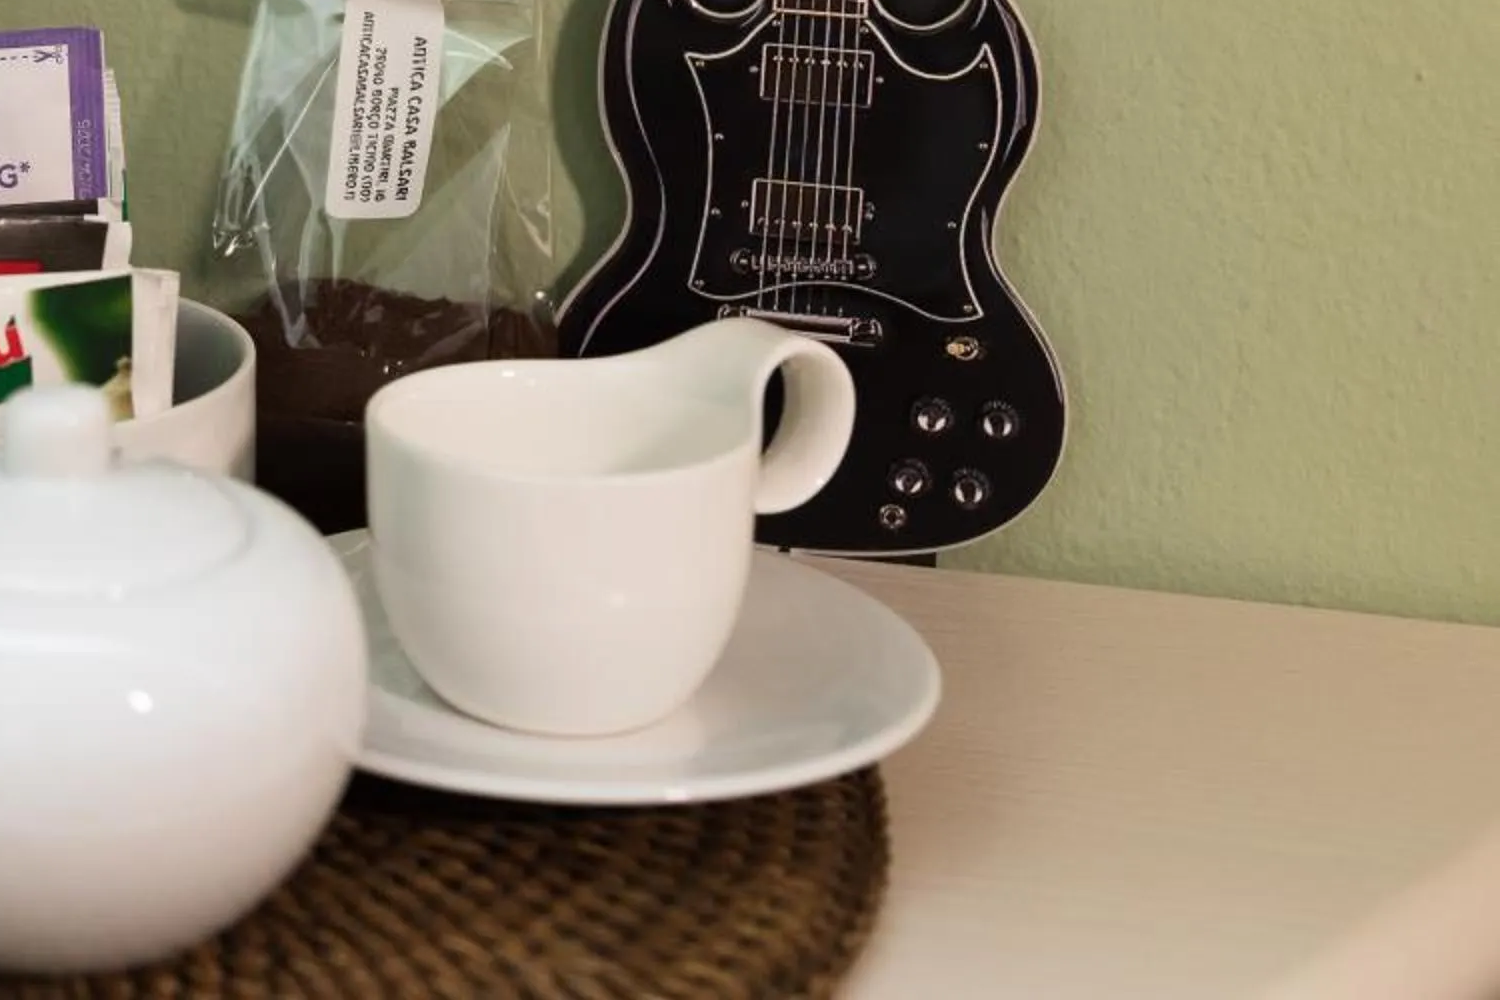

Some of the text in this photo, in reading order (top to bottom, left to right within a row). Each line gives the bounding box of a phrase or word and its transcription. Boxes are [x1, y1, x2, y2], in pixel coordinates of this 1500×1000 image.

[383, 87, 400, 131] PIAZZA
[394, 36, 428, 201] ANTICA CASA BALSARI
